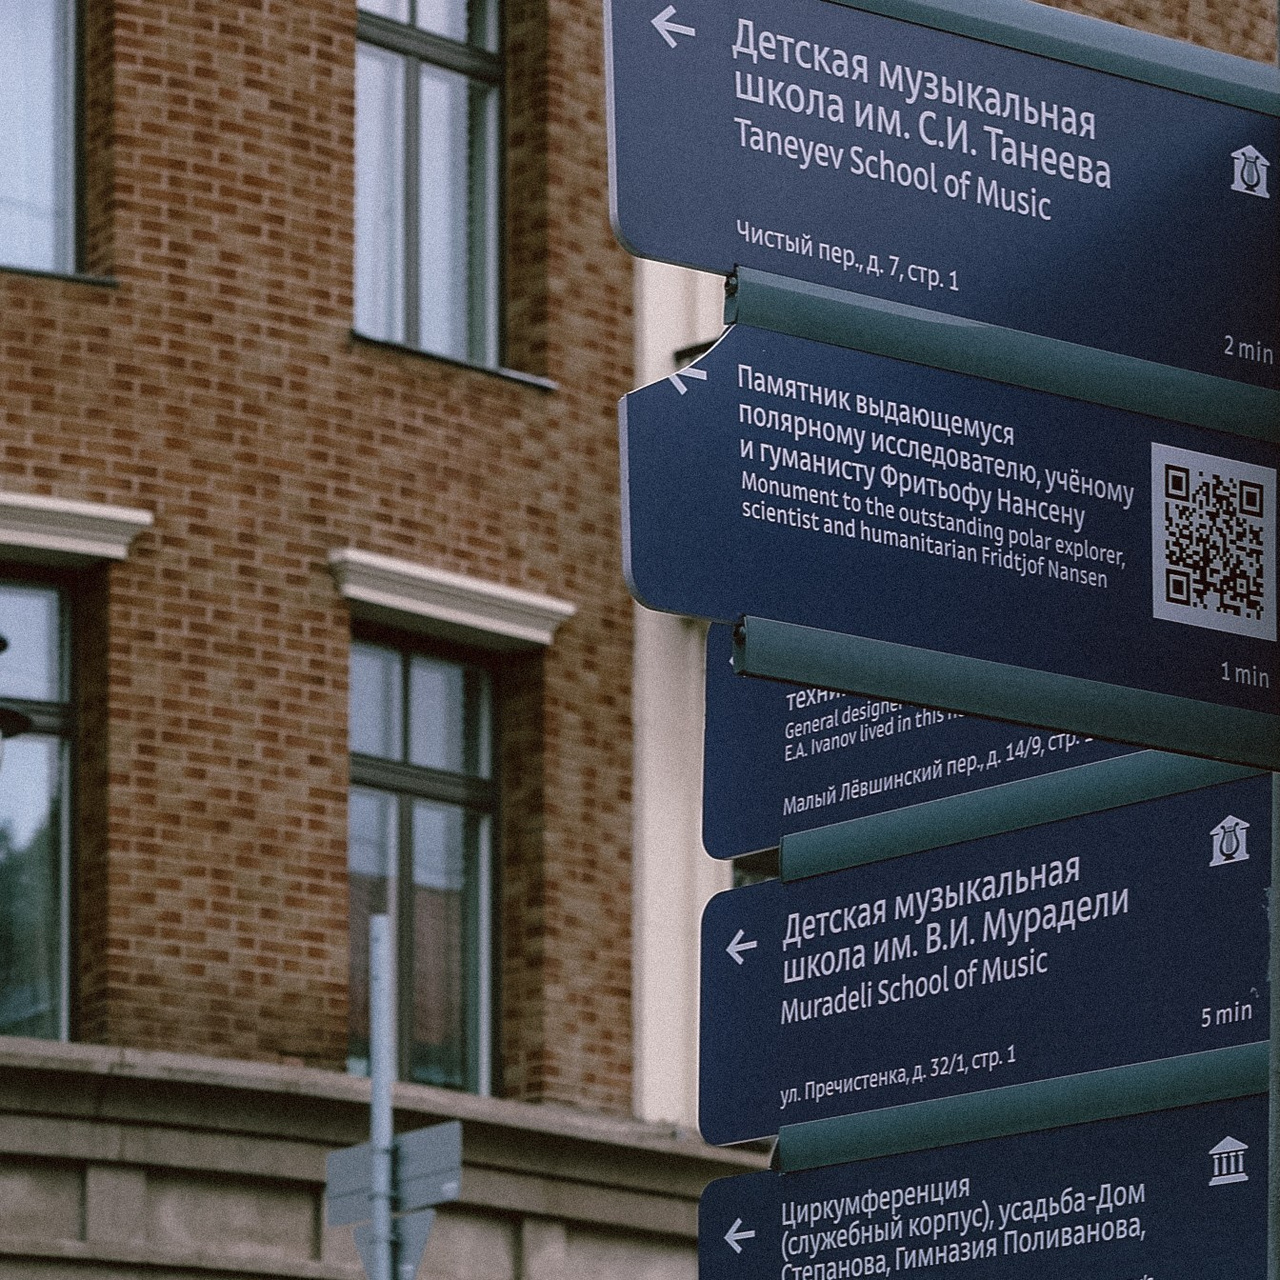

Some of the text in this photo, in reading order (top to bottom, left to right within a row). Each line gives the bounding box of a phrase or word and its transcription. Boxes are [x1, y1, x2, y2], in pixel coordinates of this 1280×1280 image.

[731, 18, 1095, 140] Детская музыкальная
[734, 117, 1051, 220] Taneyev School of Music
[735, 71, 1111, 189] школа им. С.И. Танеева
[736, 219, 959, 291] Чистый пер., д. 7, стр. 1
[1224, 335, 1273, 365] 2 min
[738, 364, 1014, 447] Памятник выдающемуся
[739, 403, 1135, 510] полярному исследователю, учёному
[740, 439, 1085, 533] и гуманисту Фритьофу Нансену
[741, 470, 1126, 570] Monument to the outstanding polar explorer,
[742, 500, 1107, 588] scientist and humanitarian Fridtjof Nansen
[786, 688, 846, 711] техн
[1221, 661, 1269, 688] 1 min
[784, 742, 808, 762] E.A.
[811, 730, 857, 755] Ivanov
[860, 716, 894, 742] lived
[897, 715, 911, 733] in
[915, 708, 945, 728] this
[785, 709, 839, 739] General
[783, 785, 836, 816] Малый
[839, 759, 943, 802] Лёвшинский
[947, 755, 984, 776] пер.,
[986, 750, 1003, 770] д.
[1006, 736, 1046, 762] 14/9,
[782, 856, 1080, 952] Детская музыкальная
[784, 888, 1128, 984] школа им. В.И. Мурадели
[781, 948, 1048, 1025] Muradeli School of Music
[1201, 1001, 1253, 1028] 5 min
[780, 1044, 1016, 1110] ул. Пречистенка, д. 32/1, стр. 1
[781, 1183, 1145, 1262] (служебный корпус), усадьба-Дом
[782, 1178, 970, 1230] Циркумференция
[895, 1237, 997, 1271] Гимназия
[1004, 1217, 1146, 1255] Поливанова,
